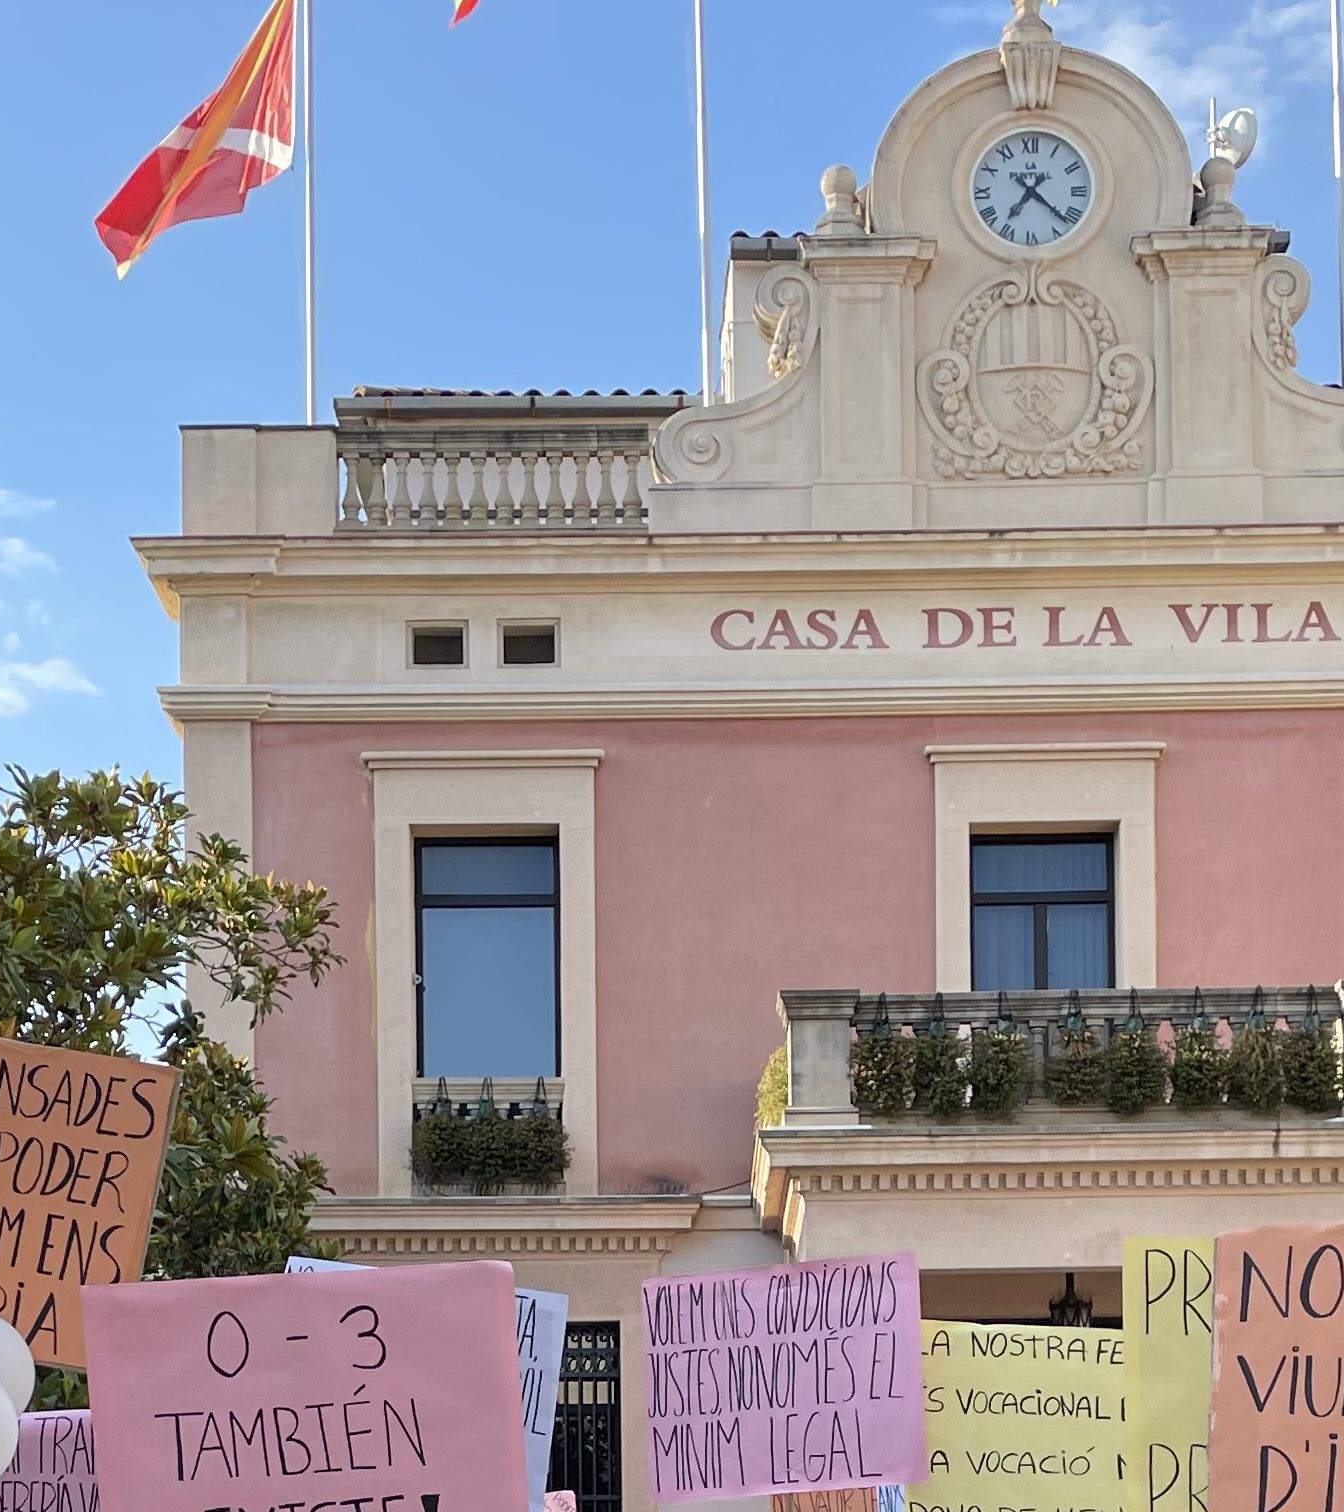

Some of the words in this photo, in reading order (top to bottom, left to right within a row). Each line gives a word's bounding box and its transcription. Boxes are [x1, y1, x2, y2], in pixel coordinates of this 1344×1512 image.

[709, 607, 890, 652] CASA
[921, 605, 1019, 651] DE
[1041, 604, 1133, 648] LA
[1167, 600, 1342, 645] VILA
[36, 1213, 125, 1285] ENS
[644, 1283, 707, 1347] VOLEM
[970, 1331, 1086, 1362] NOSTRA
[869, 1331, 904, 1400] EL
[154, 1384, 426, 1482] TAMBIÉN
[652, 1416, 746, 1493] MINIM
[769, 1409, 883, 1485] LEGAL
